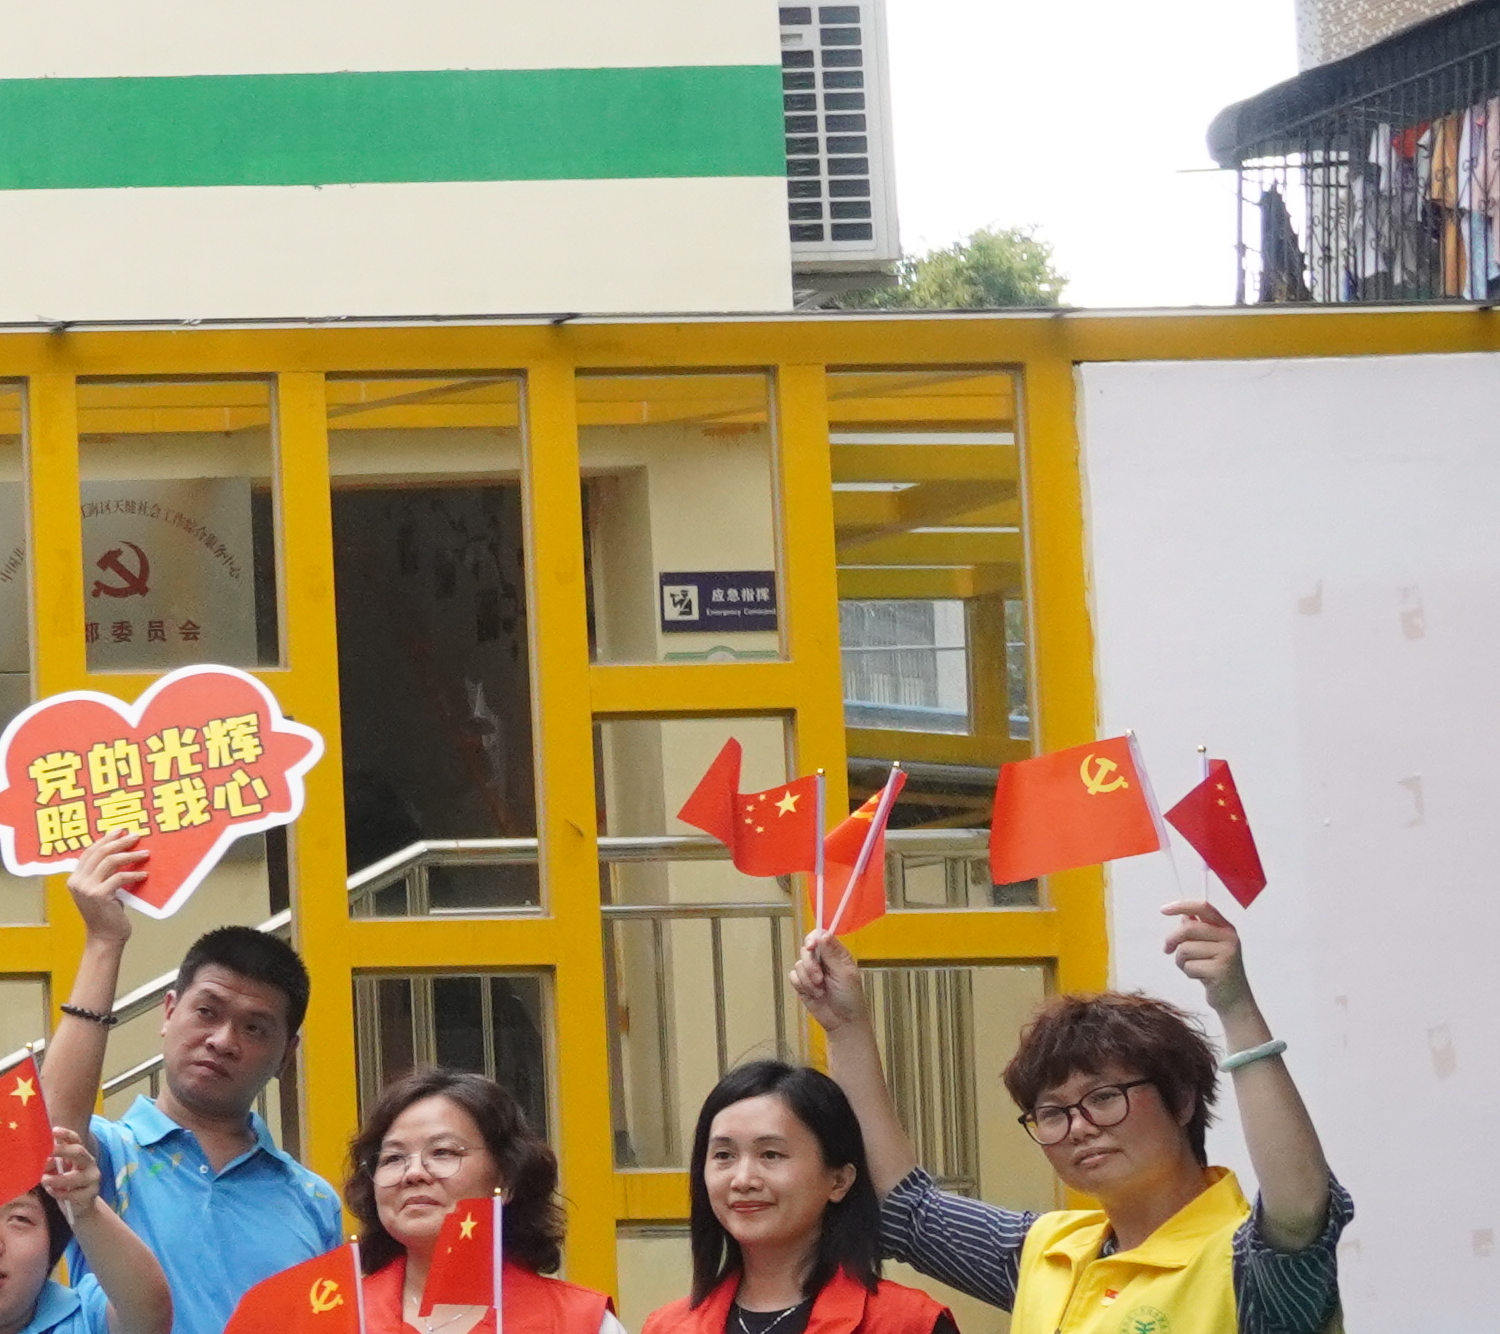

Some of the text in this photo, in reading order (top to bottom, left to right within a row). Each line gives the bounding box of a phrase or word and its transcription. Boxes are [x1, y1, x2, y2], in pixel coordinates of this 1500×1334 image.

[28, 712, 264, 805] 党的光辉
[35, 769, 271, 857] 照亮我心
